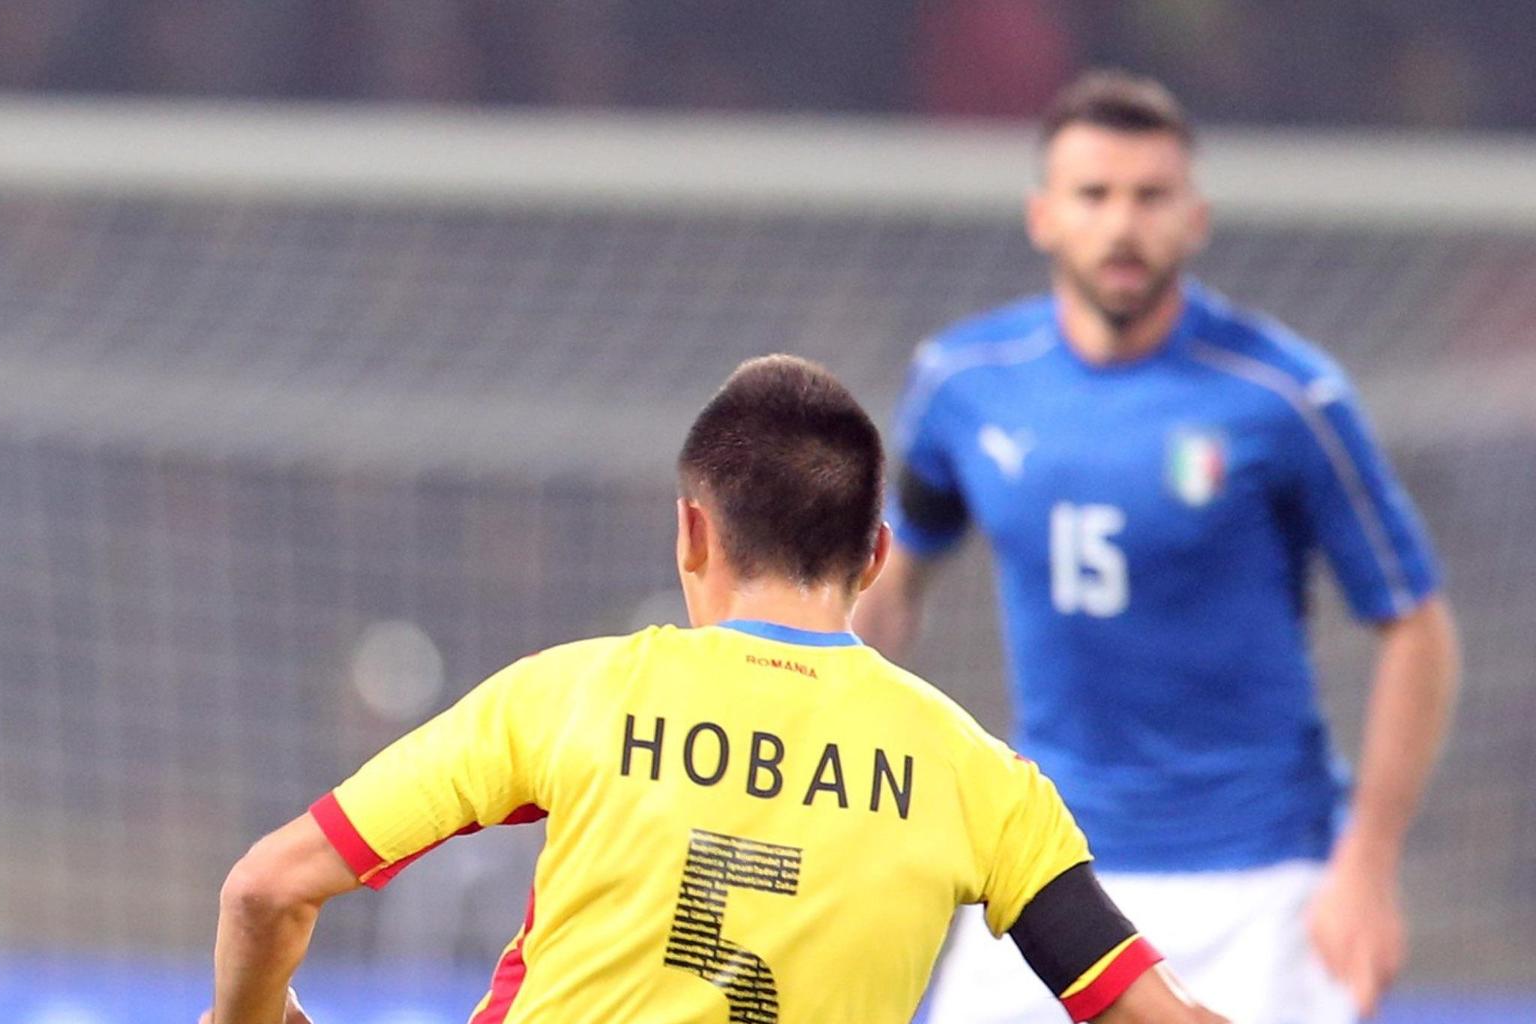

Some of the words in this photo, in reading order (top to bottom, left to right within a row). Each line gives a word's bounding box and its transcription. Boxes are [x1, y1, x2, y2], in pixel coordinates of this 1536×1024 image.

[1049, 501, 1131, 619] 15
[745, 655, 818, 680] ROMANIA
[619, 714, 915, 820] HOBAN
